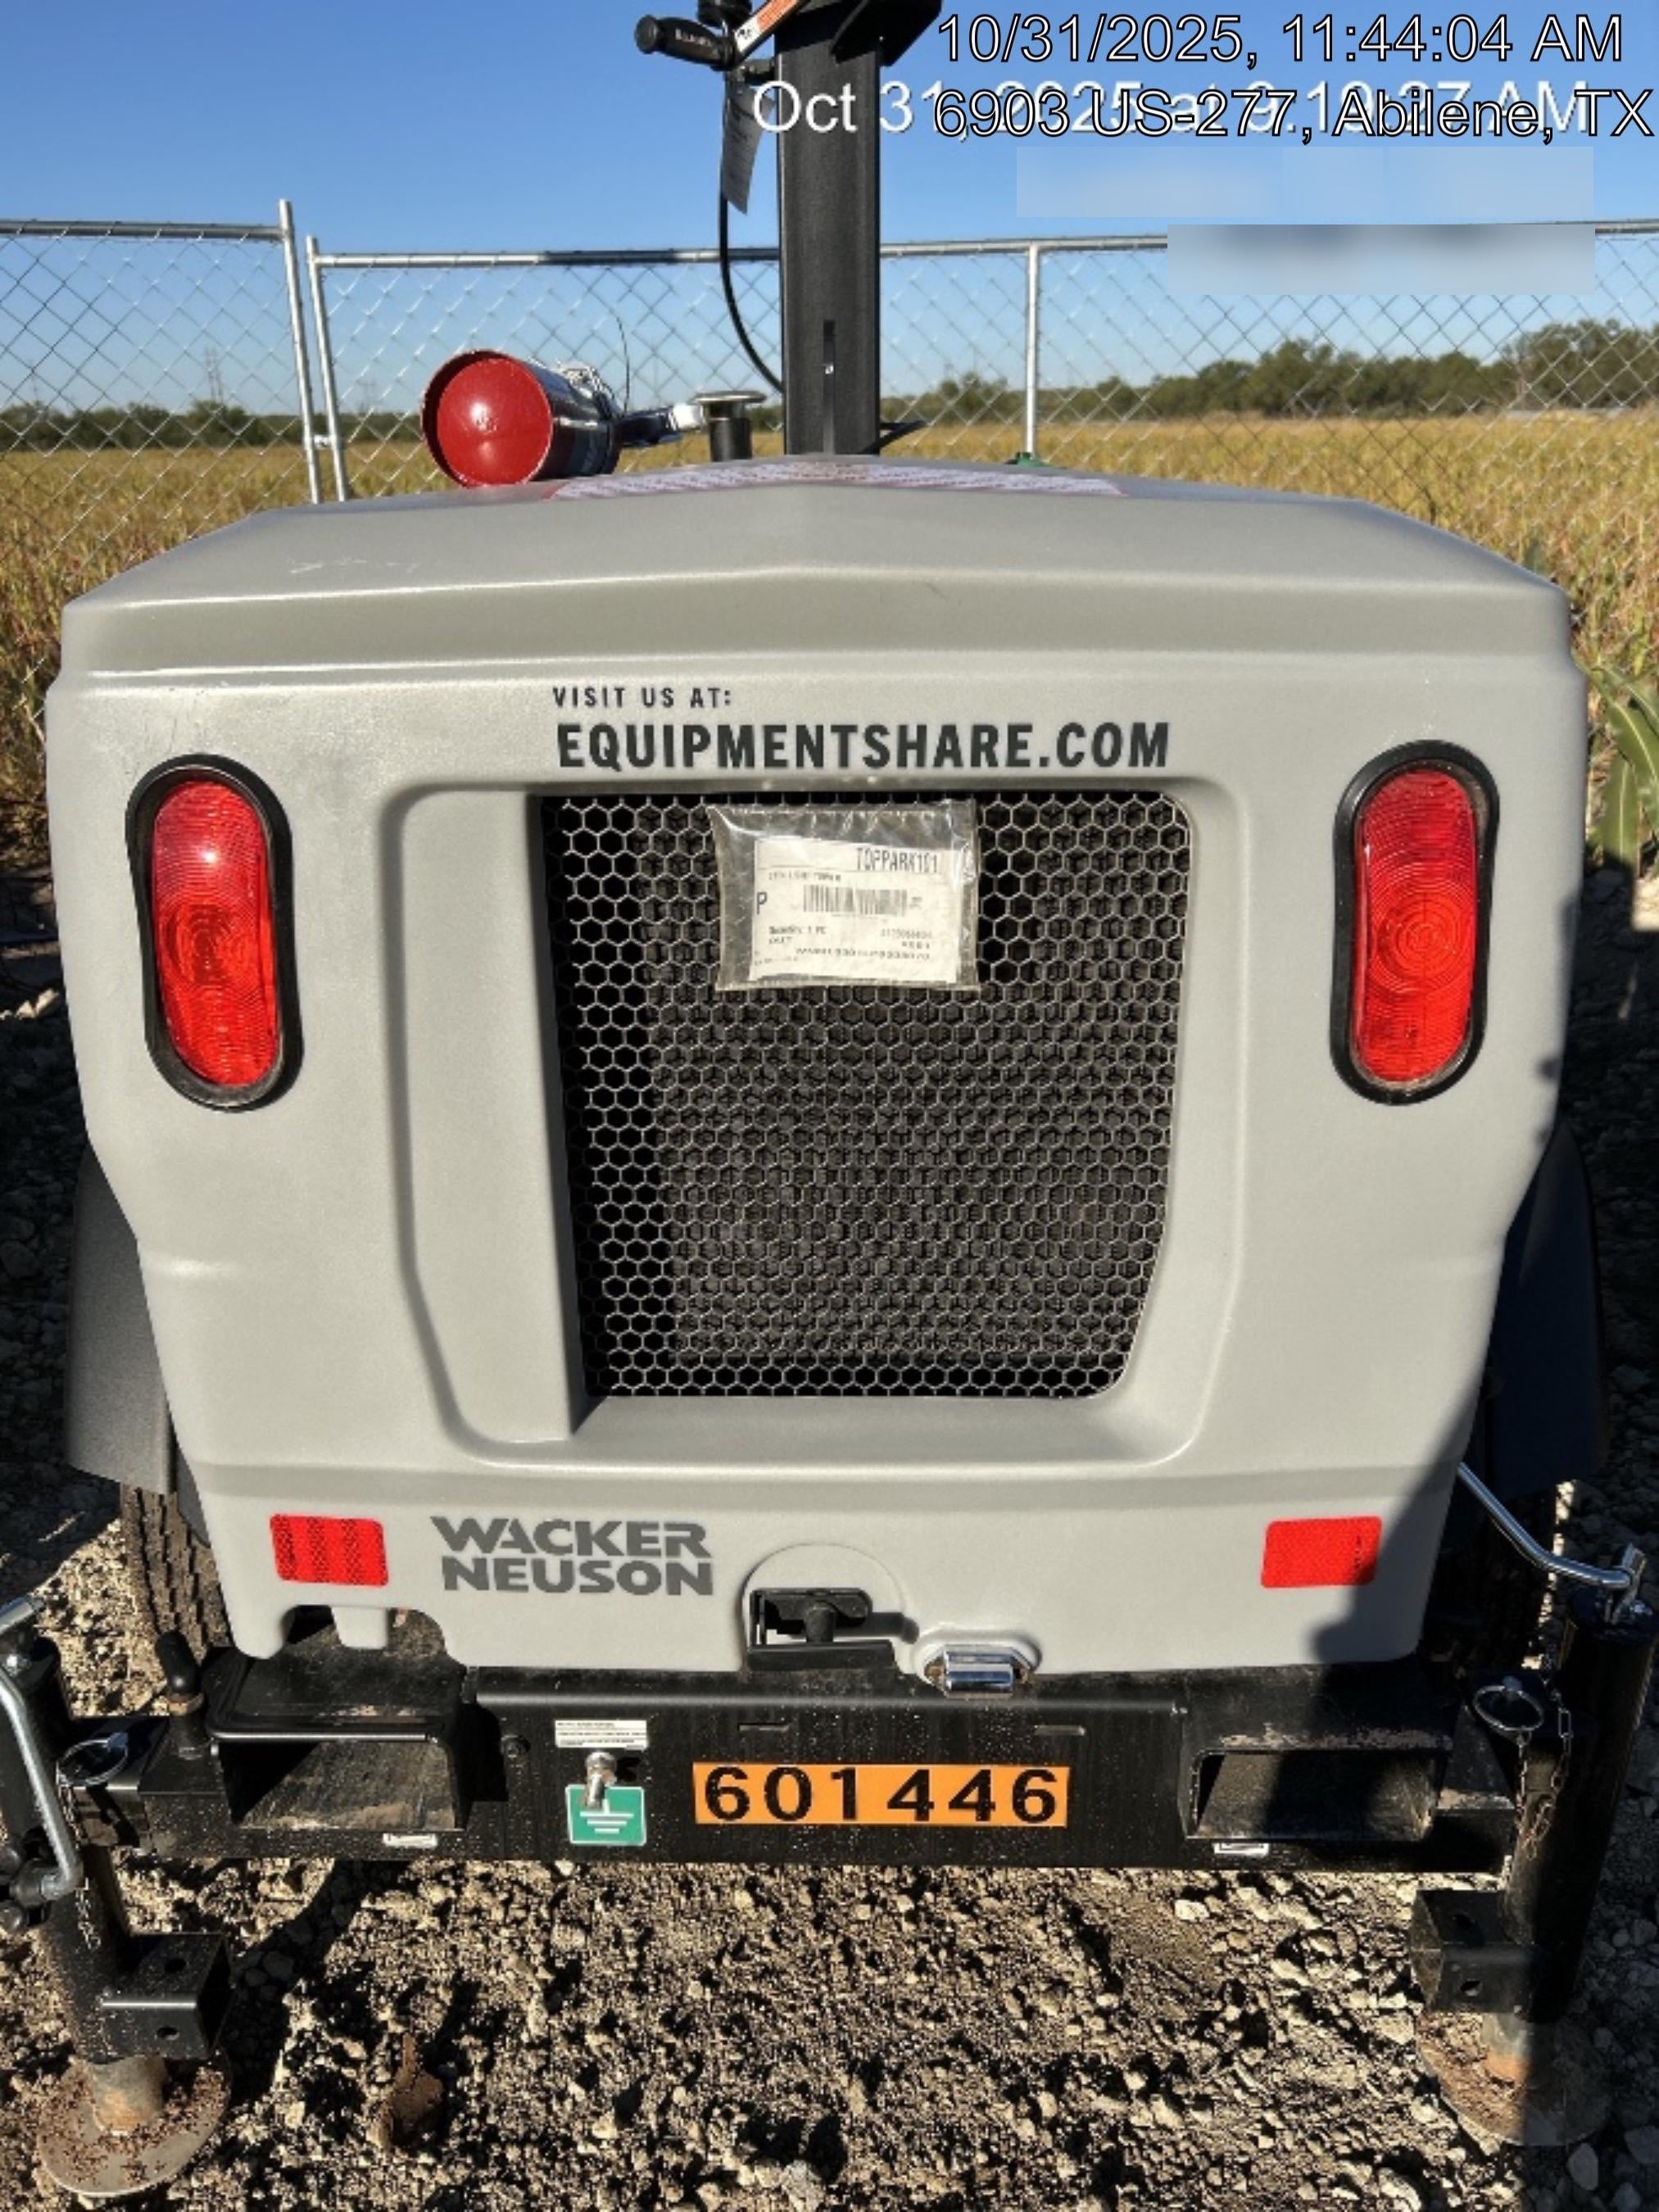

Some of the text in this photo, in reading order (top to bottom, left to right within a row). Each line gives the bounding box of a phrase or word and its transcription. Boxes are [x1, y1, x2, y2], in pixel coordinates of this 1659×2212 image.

[552, 687, 732, 709] VISIT US AT:
[556, 722, 1170, 773] EQUIPMENTSHARE.COM
[429, 1516, 713, 1557] WACKER
[442, 1555, 714, 1596] NEUSON
[705, 1766, 1058, 1824] 601446
